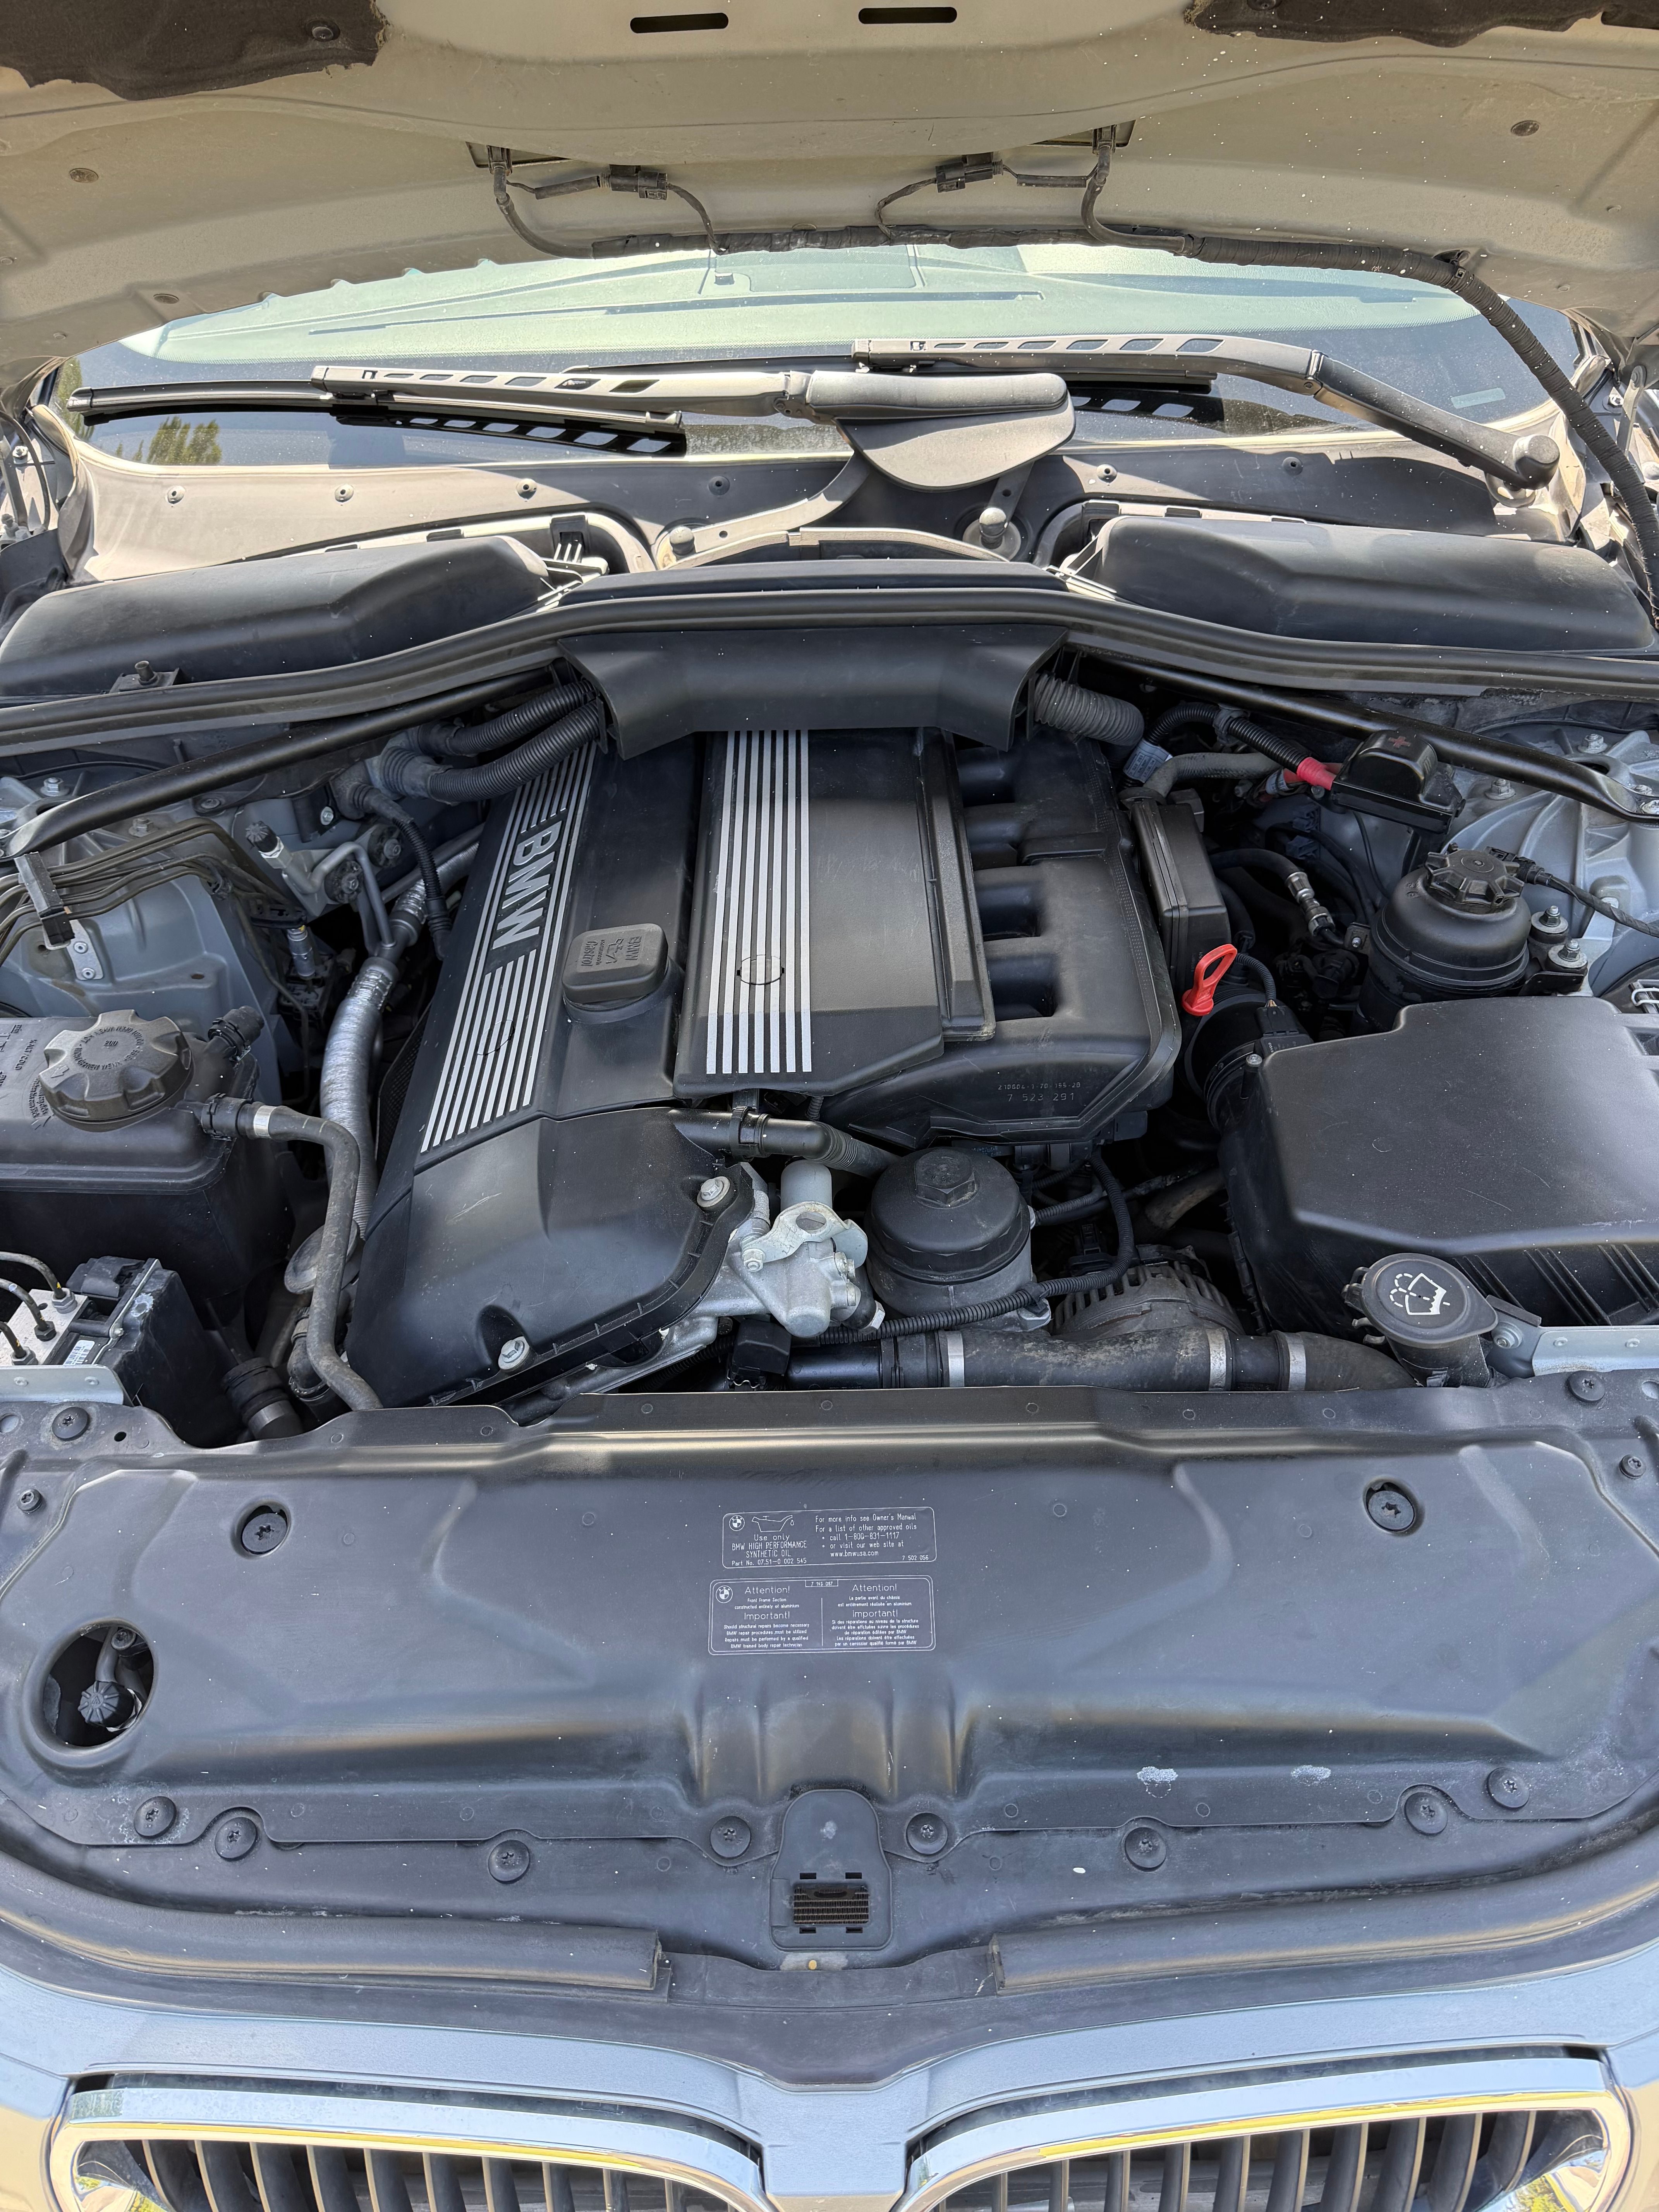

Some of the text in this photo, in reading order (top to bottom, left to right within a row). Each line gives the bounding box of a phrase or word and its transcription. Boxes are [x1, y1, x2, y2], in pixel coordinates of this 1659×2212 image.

[492, 820, 562, 950] BMW
[581, 940, 598, 966] Castrol
[625, 936, 642, 960] BMW
[15, 1039, 38, 1070] KALT/COLD
[1022, 1093, 1044, 1101] 523
[1053, 1092, 1074, 1101] 291
[877, 1523, 903, 1532] approved
[773, 1533, 790, 1542] only
[845, 1532, 900, 1540] 1-800-831-1117
[732, 1540, 807, 1551] BMW HIGH PERFORMANCE
[746, 1549, 778, 1558] SYNTHETIC
[744, 1585, 790, 1595] Attention!
[852, 1583, 897, 1592] Attention!
[744, 1611, 790, 1621] Important!
[852, 1609, 898, 1619] Important!
